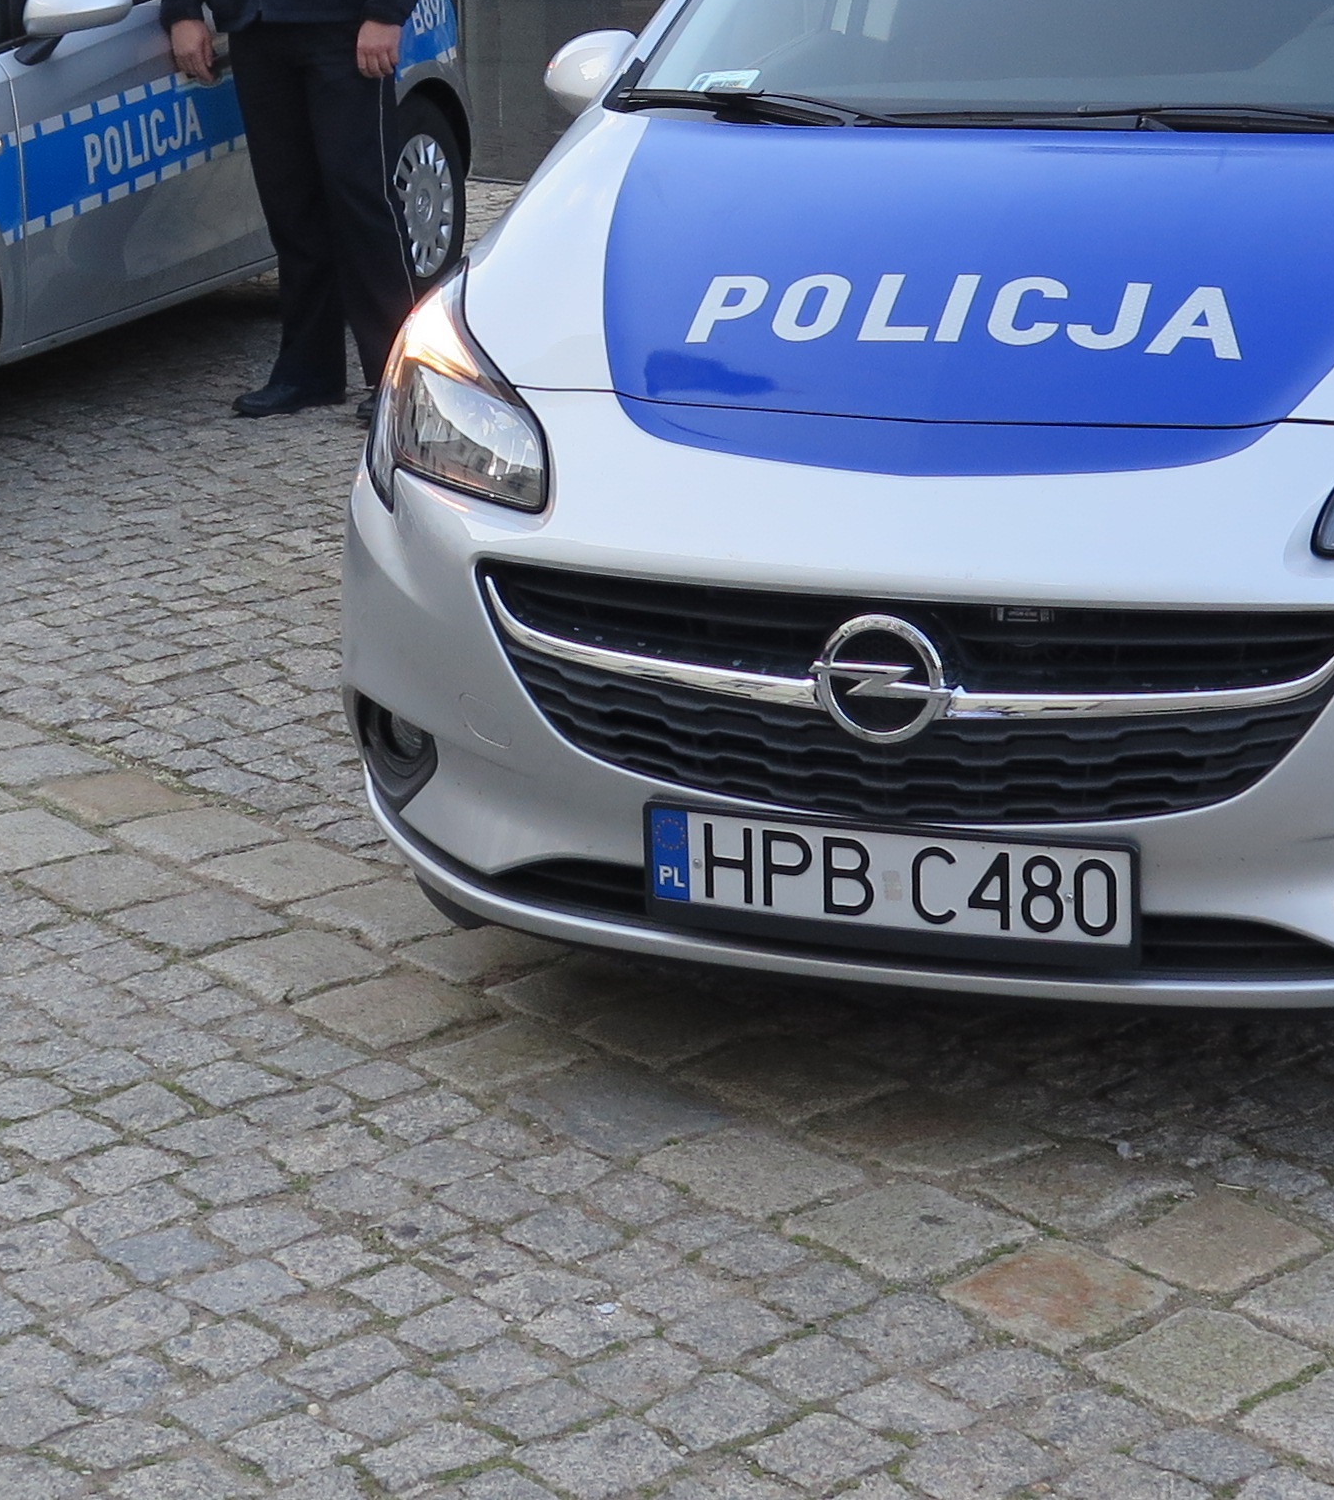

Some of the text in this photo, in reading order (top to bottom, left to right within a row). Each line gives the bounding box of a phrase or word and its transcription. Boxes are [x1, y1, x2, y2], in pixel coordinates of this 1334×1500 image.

[83, 96, 204, 185] POLICJA
[684, 273, 1243, 361] POLICJA
[658, 864, 686, 889] PL
[703, 823, 1118, 938] HPB C480
